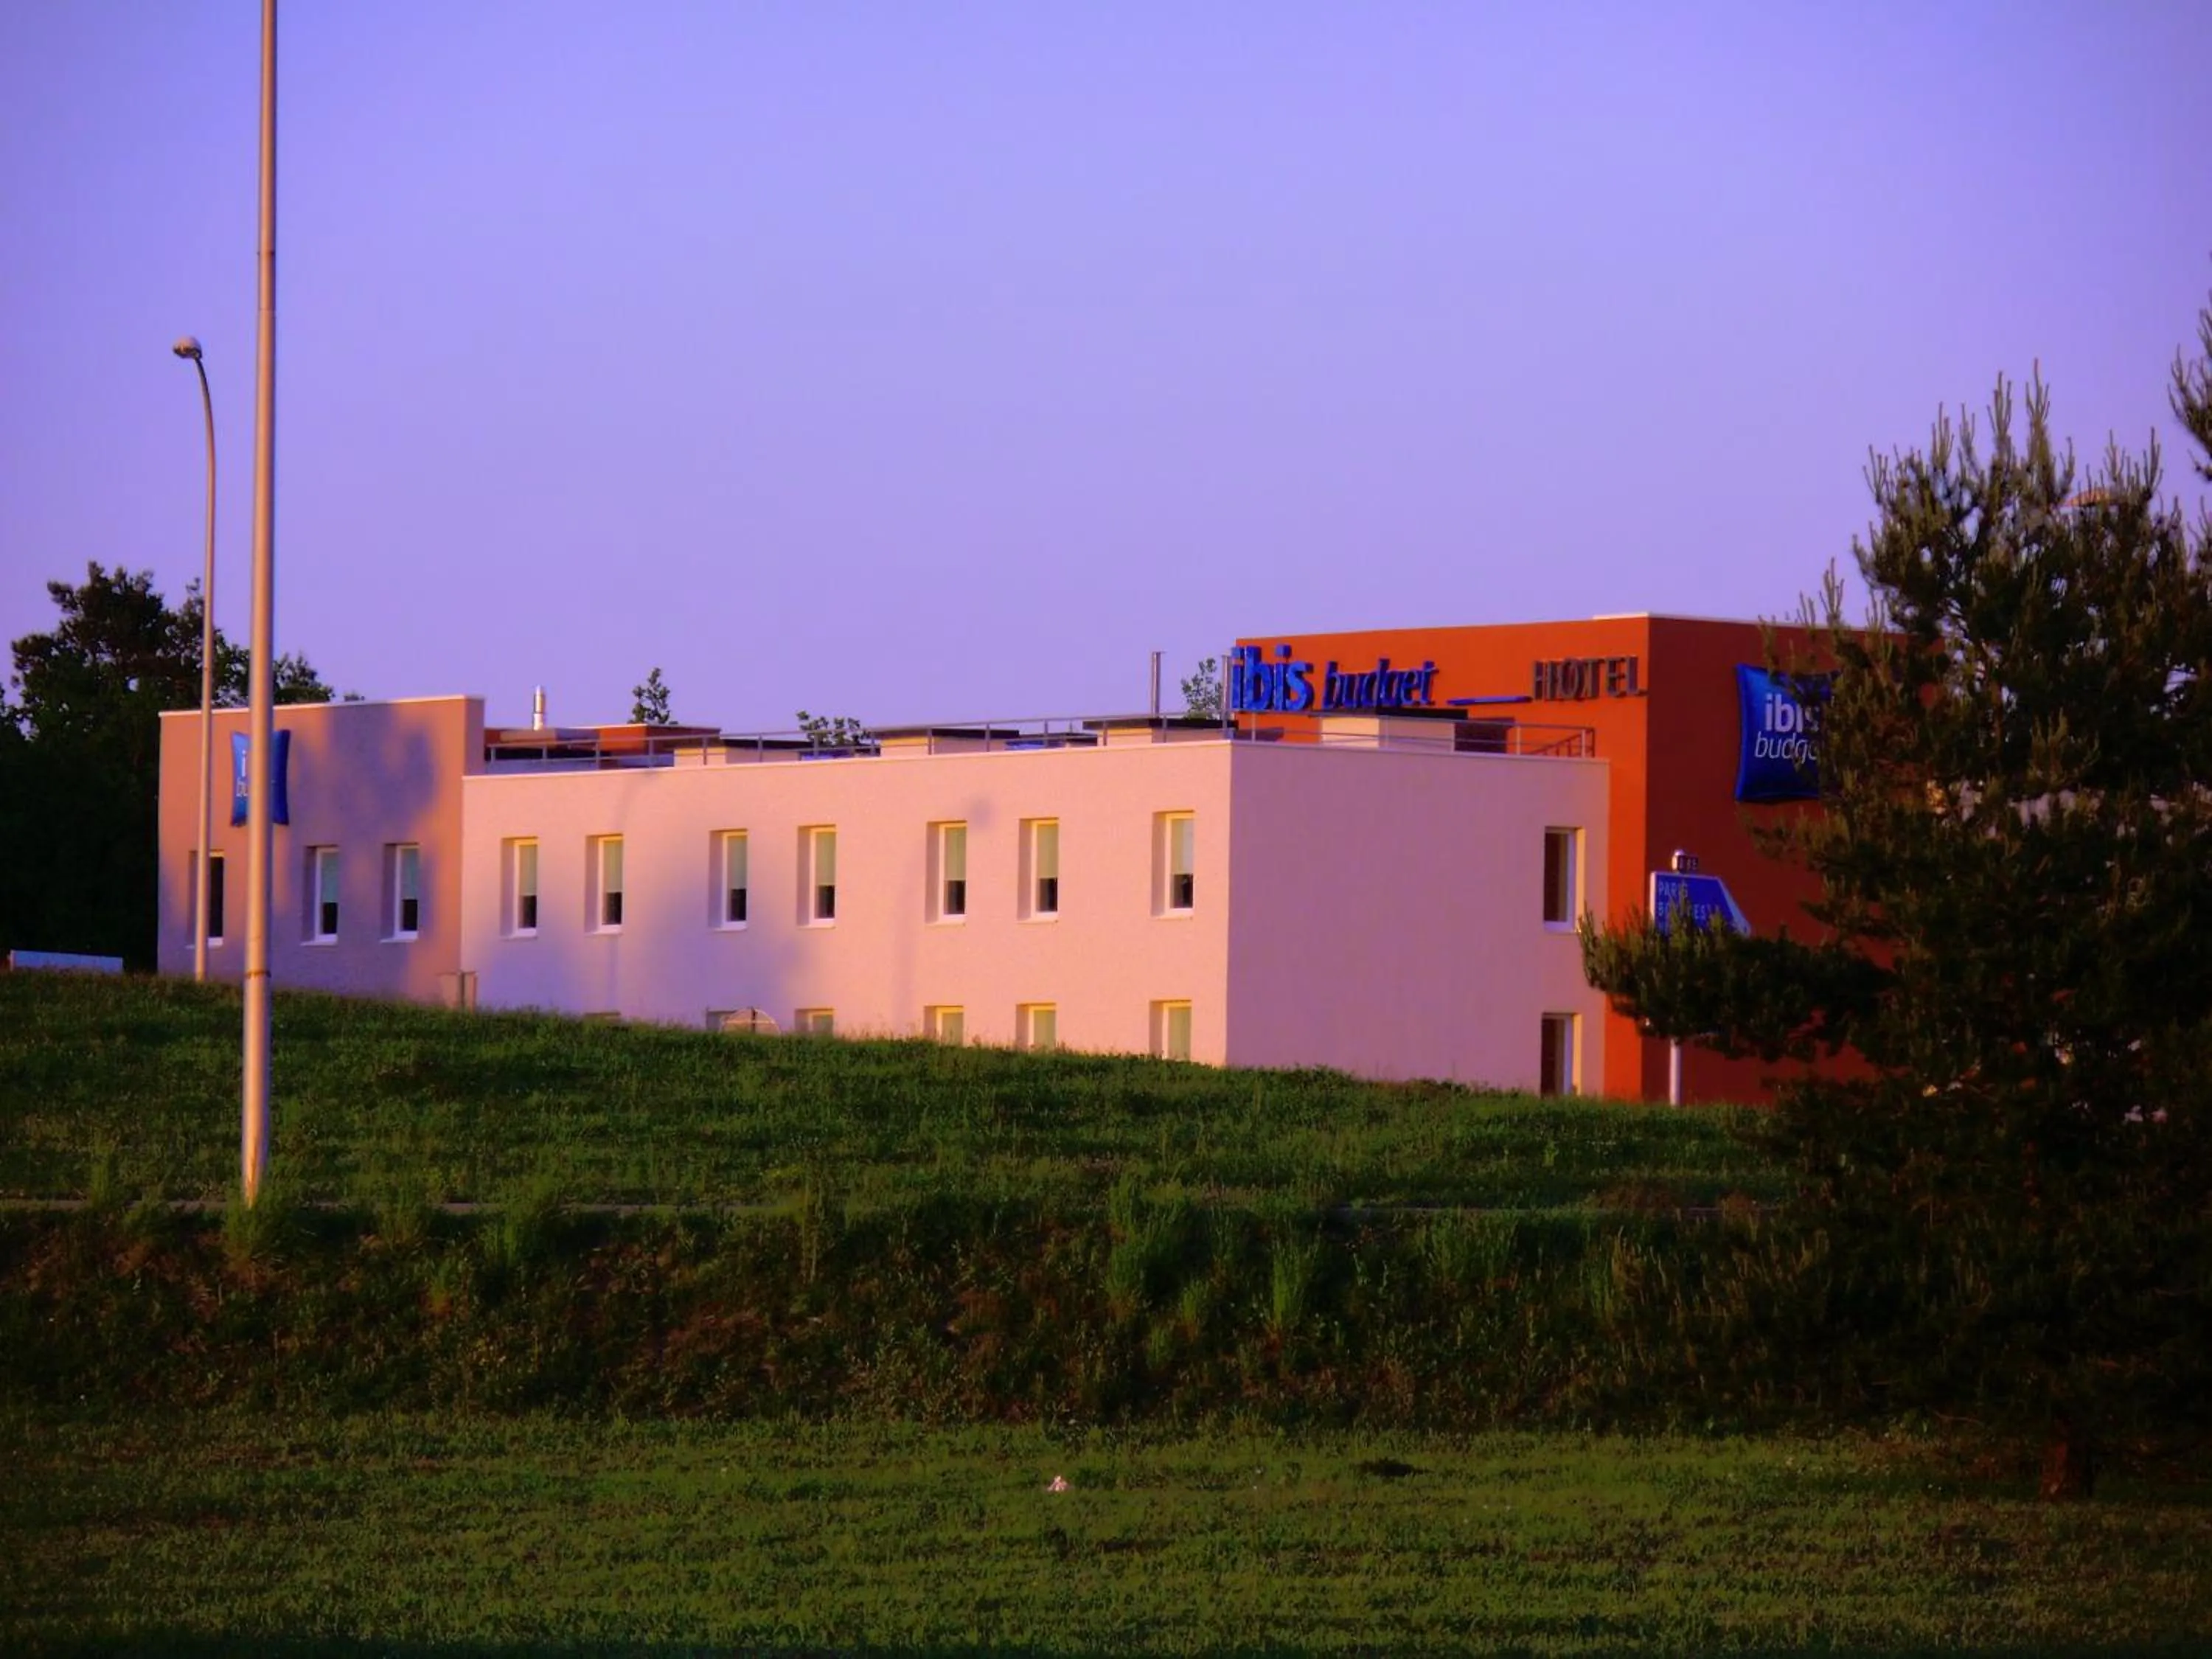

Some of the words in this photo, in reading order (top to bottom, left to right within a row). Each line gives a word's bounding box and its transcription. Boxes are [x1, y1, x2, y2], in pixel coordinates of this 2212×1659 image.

[1231, 644, 1314, 712] ibis
[1322, 658, 1439, 710] budget
[1533, 655, 1647, 701] HOTEL
[1754, 731, 1819, 764] budge
